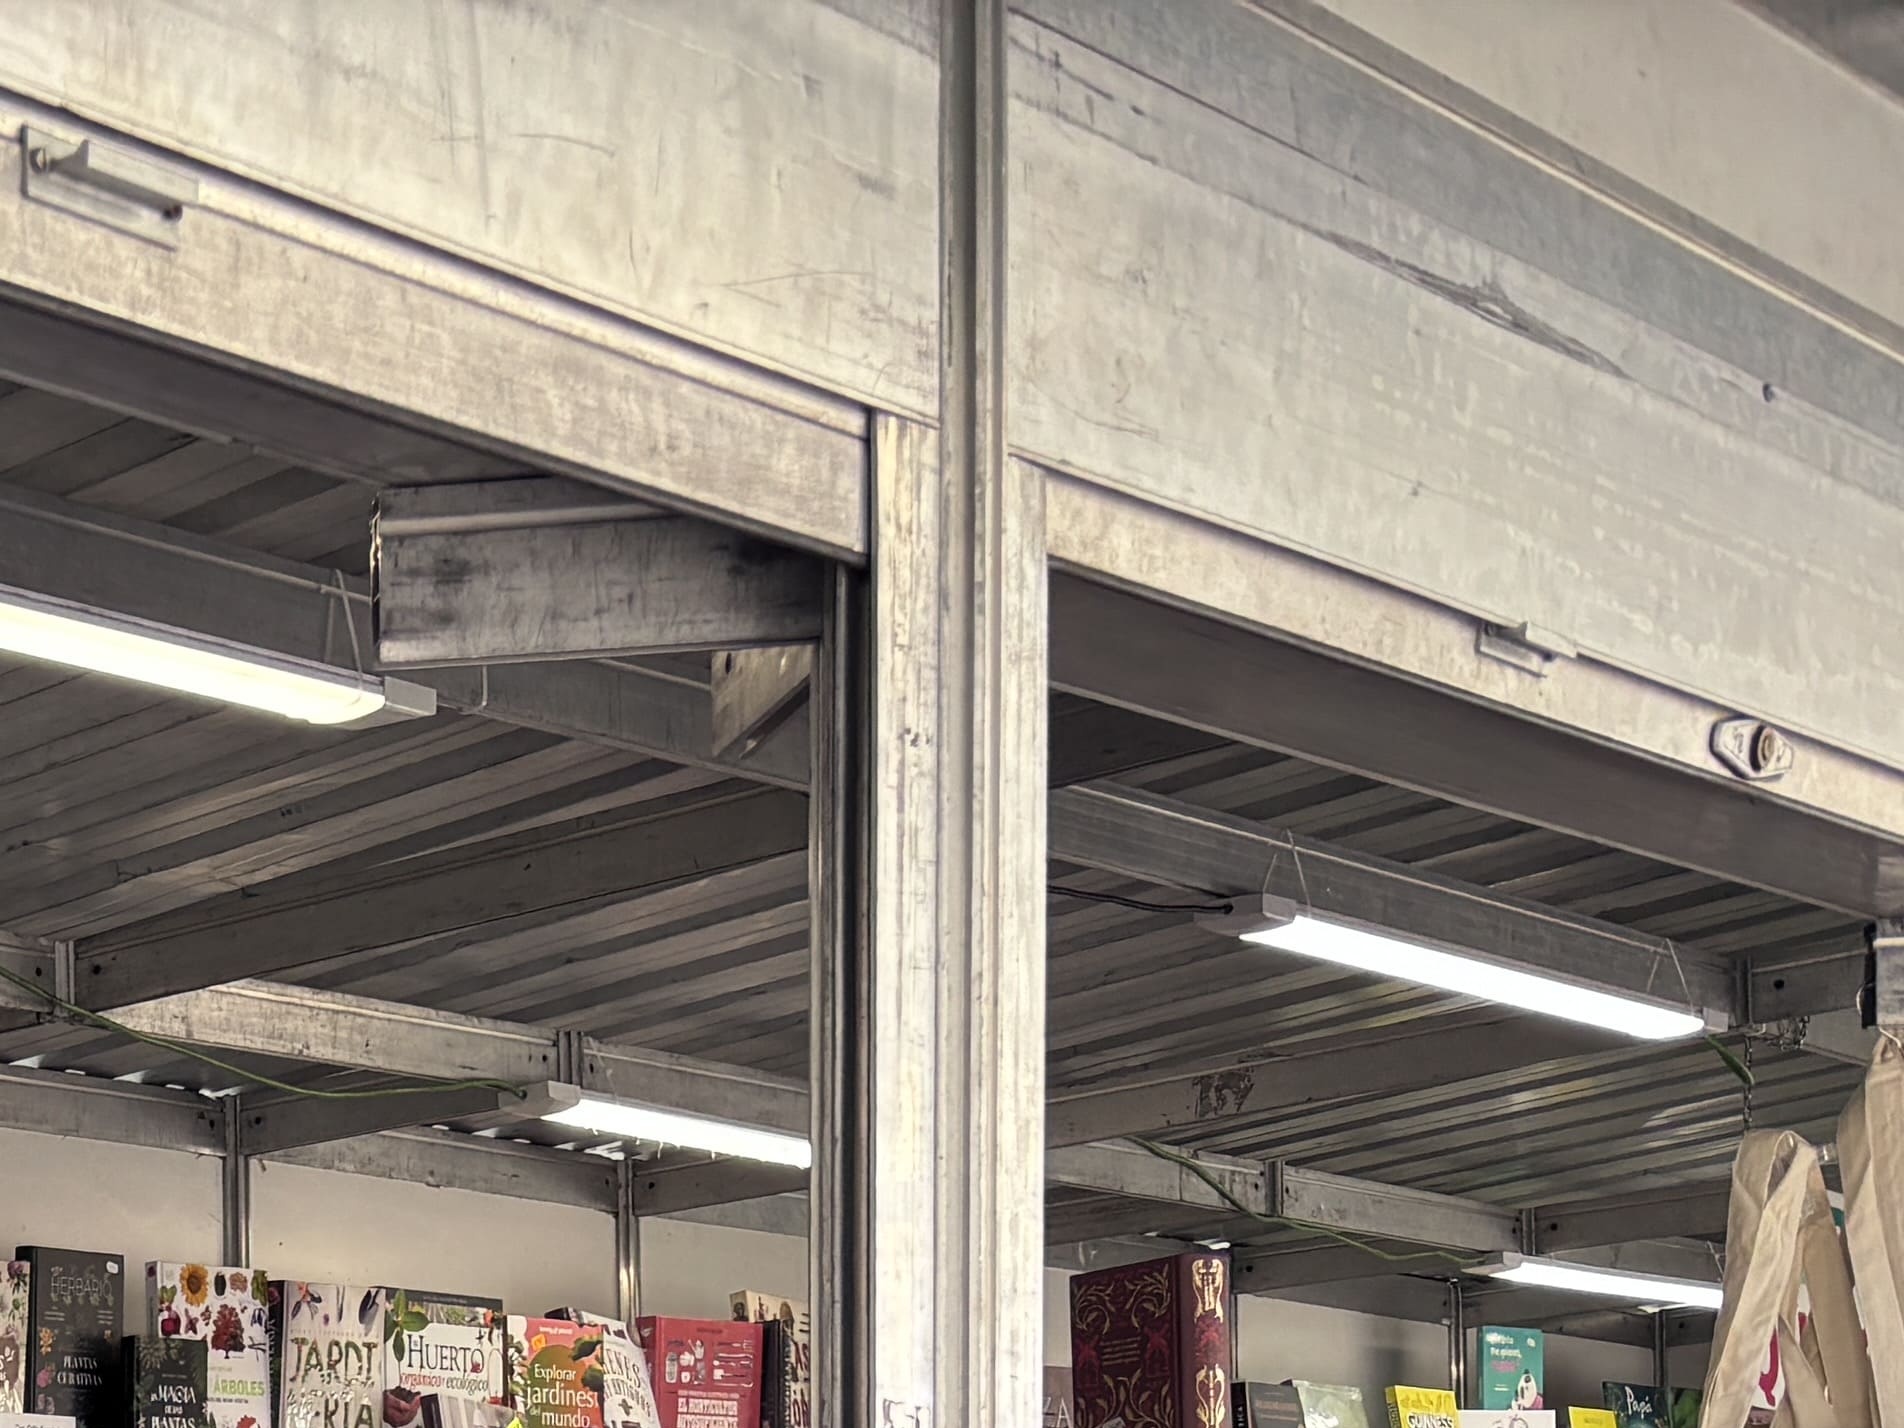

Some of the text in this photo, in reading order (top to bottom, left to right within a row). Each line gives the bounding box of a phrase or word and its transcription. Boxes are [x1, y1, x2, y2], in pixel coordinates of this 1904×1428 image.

[407, 1336, 485, 1374] HUERTO
[534, 1363, 576, 1382] Explorar
[541, 1408, 590, 1427] mundo
